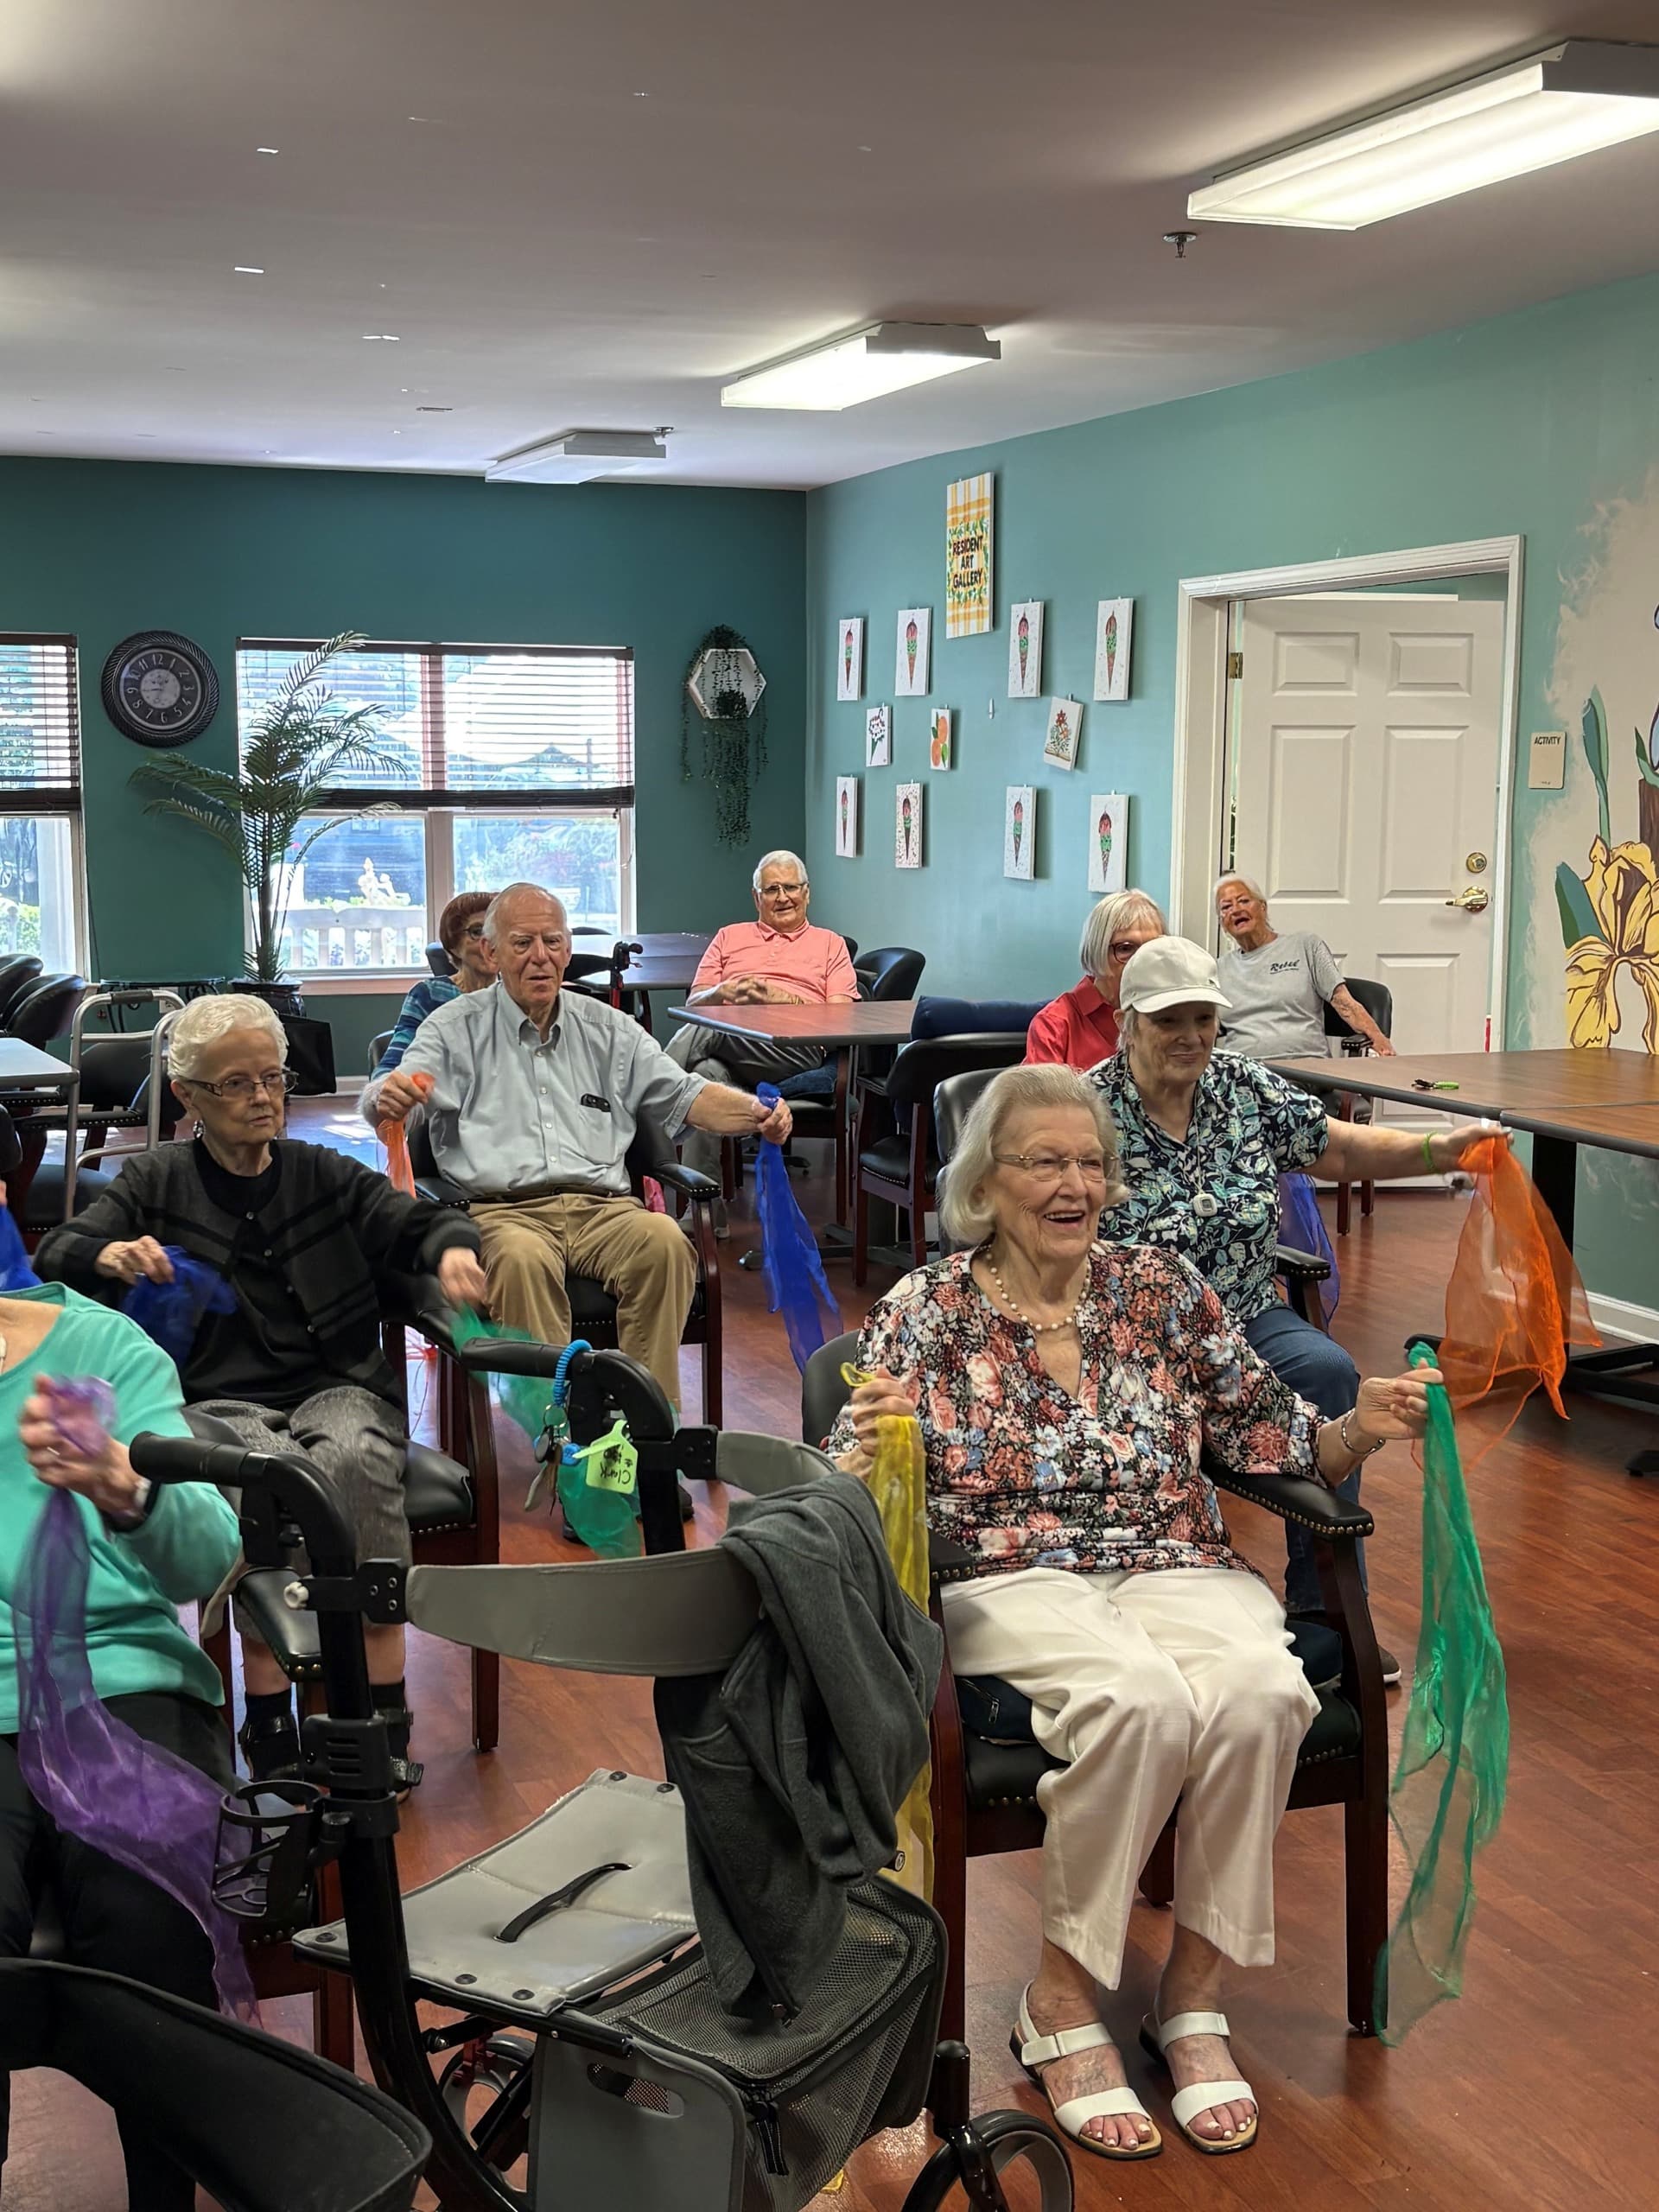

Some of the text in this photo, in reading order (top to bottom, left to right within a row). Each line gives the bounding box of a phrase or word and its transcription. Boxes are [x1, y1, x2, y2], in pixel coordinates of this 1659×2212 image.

[952, 535, 983, 556] RESIDENT
[961, 555, 974, 570] ART
[953, 568, 982, 588] GALLERY
[138, 658, 149, 671] 11
[152, 653, 163, 664] 12
[132, 699, 143, 709] 8
[161, 712, 168, 723] 6
[1534, 736, 1561, 745] ACTIVITY
